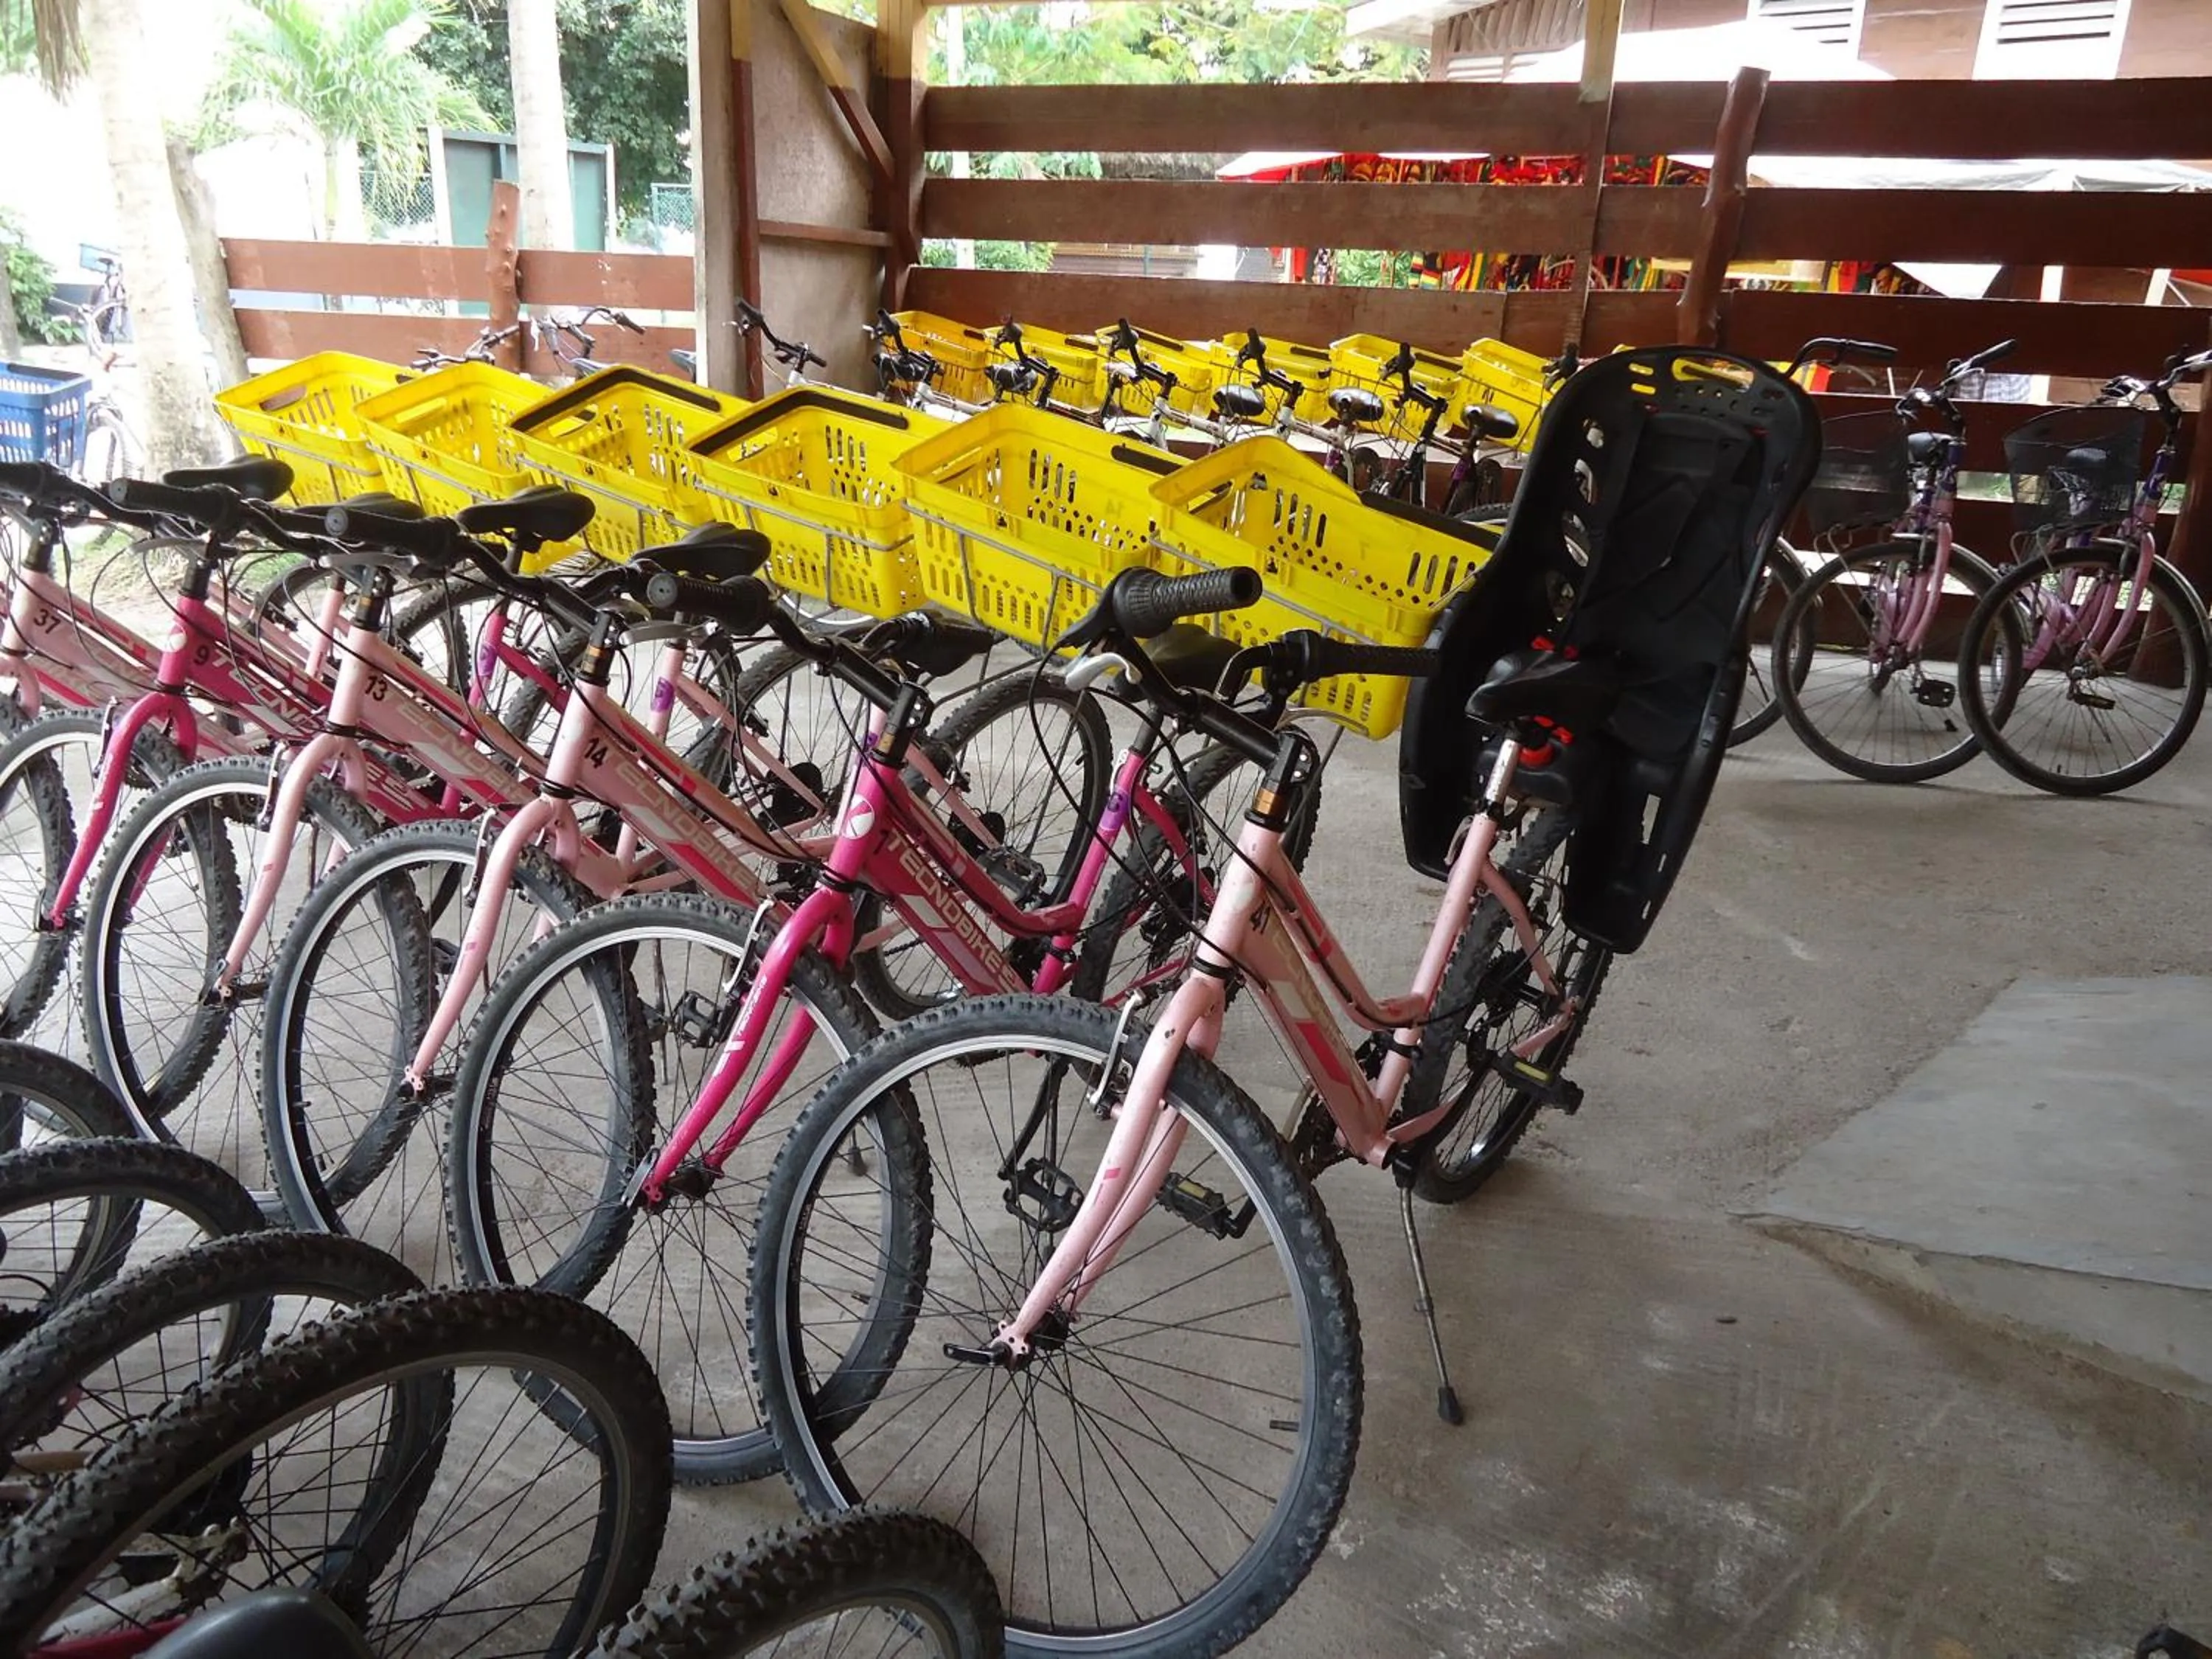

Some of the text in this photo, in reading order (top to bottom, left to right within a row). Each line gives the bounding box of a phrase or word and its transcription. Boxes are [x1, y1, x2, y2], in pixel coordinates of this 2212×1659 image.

[33, 608, 61, 634] 37
[193, 644, 210, 664] 9
[364, 674, 389, 702] 13
[583, 737, 609, 769] 14
